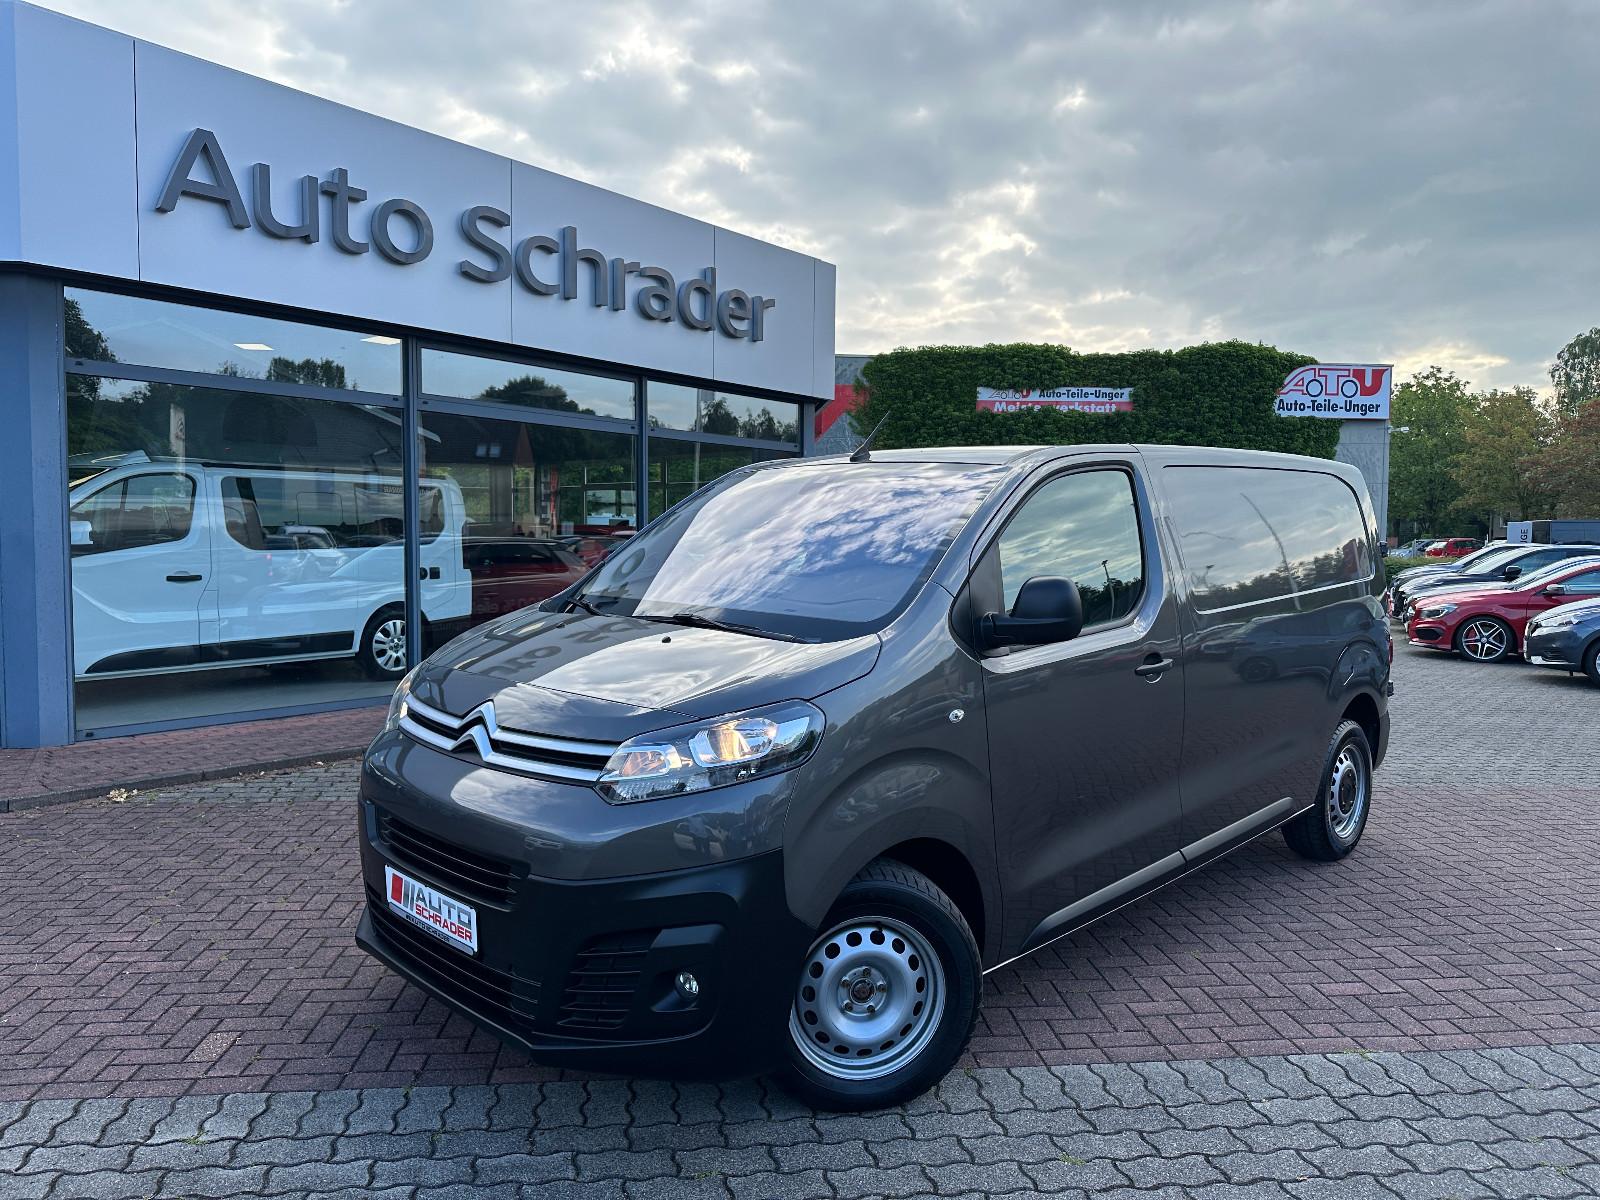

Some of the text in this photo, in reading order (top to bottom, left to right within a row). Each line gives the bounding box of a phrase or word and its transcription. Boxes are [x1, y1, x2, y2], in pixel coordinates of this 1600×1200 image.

[156, 128, 775, 343] Auto Schrader
[1038, 388, 1125, 401] Auto-Teile-Unger
[1277, 399, 1380, 416] Auto-Teile-Unger
[415, 887, 472, 930] AUTO
[415, 903, 473, 943] SCHRADER
